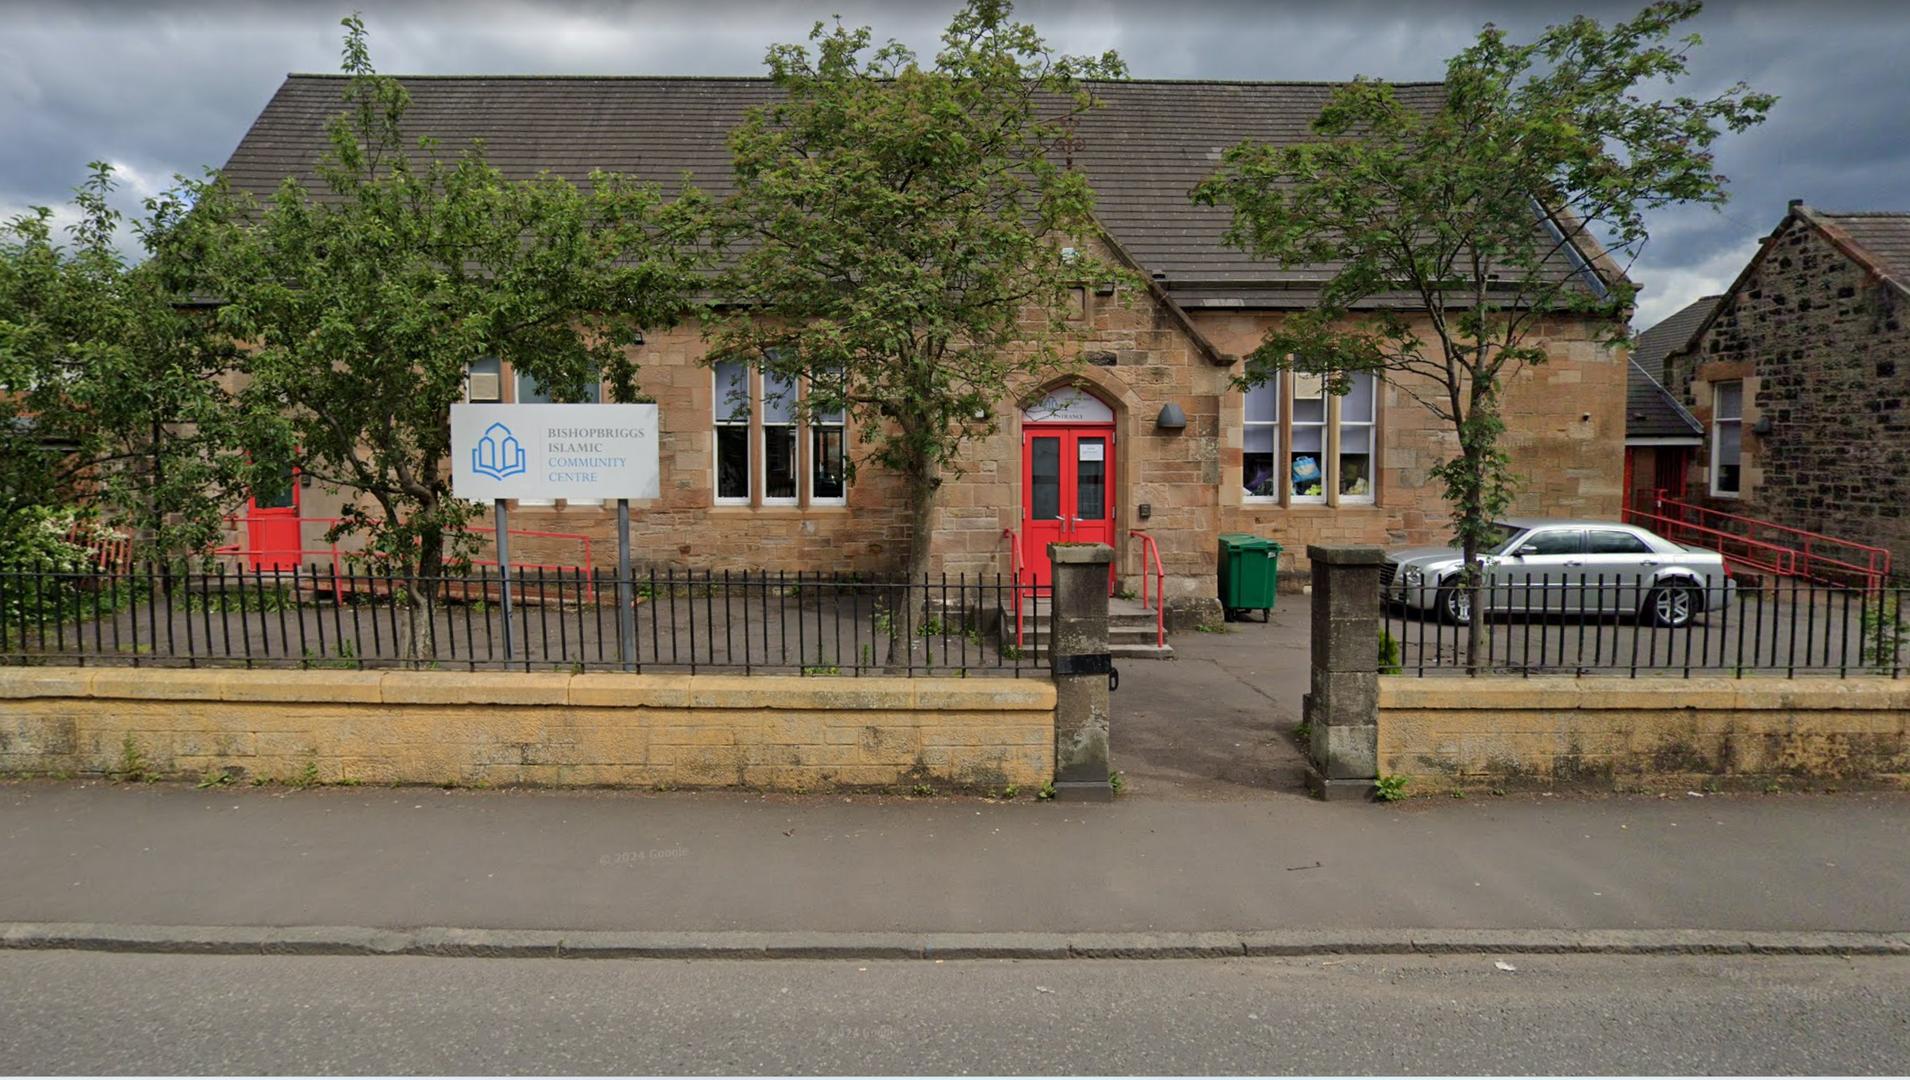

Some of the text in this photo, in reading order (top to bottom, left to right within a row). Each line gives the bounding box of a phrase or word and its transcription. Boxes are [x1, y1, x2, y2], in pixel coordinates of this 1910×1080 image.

[548, 428, 645, 438] BISHOPBRIGGS
[548, 443, 603, 453] ISLAMIC
[548, 457, 627, 467] COMMUNITY
[548, 472, 598, 482] CENTRE
